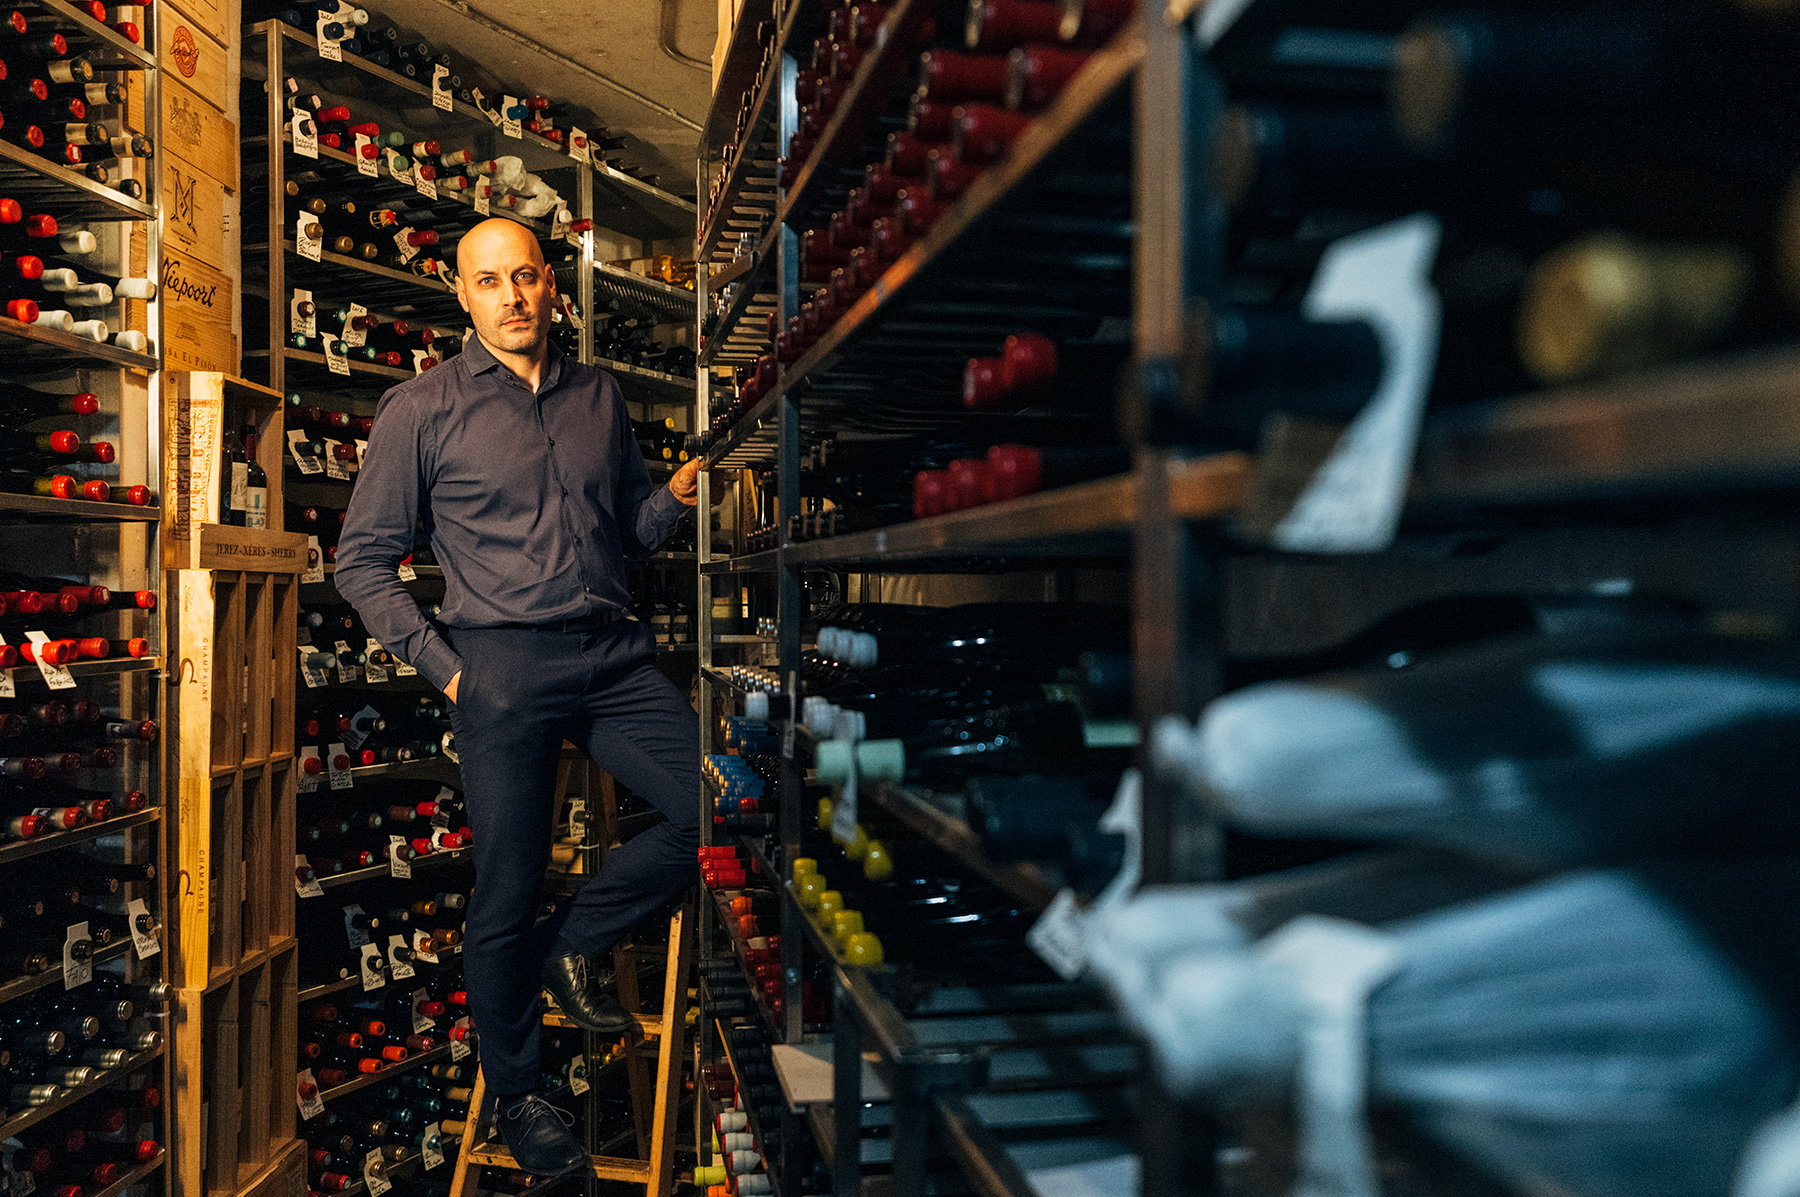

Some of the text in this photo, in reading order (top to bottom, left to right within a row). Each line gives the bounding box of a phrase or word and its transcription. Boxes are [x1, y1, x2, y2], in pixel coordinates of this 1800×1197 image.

[163, 257, 216, 307] Niepoort
[207, 413, 217, 450] BODEGAS
[201, 637, 209, 703] CHAMPAGNE
